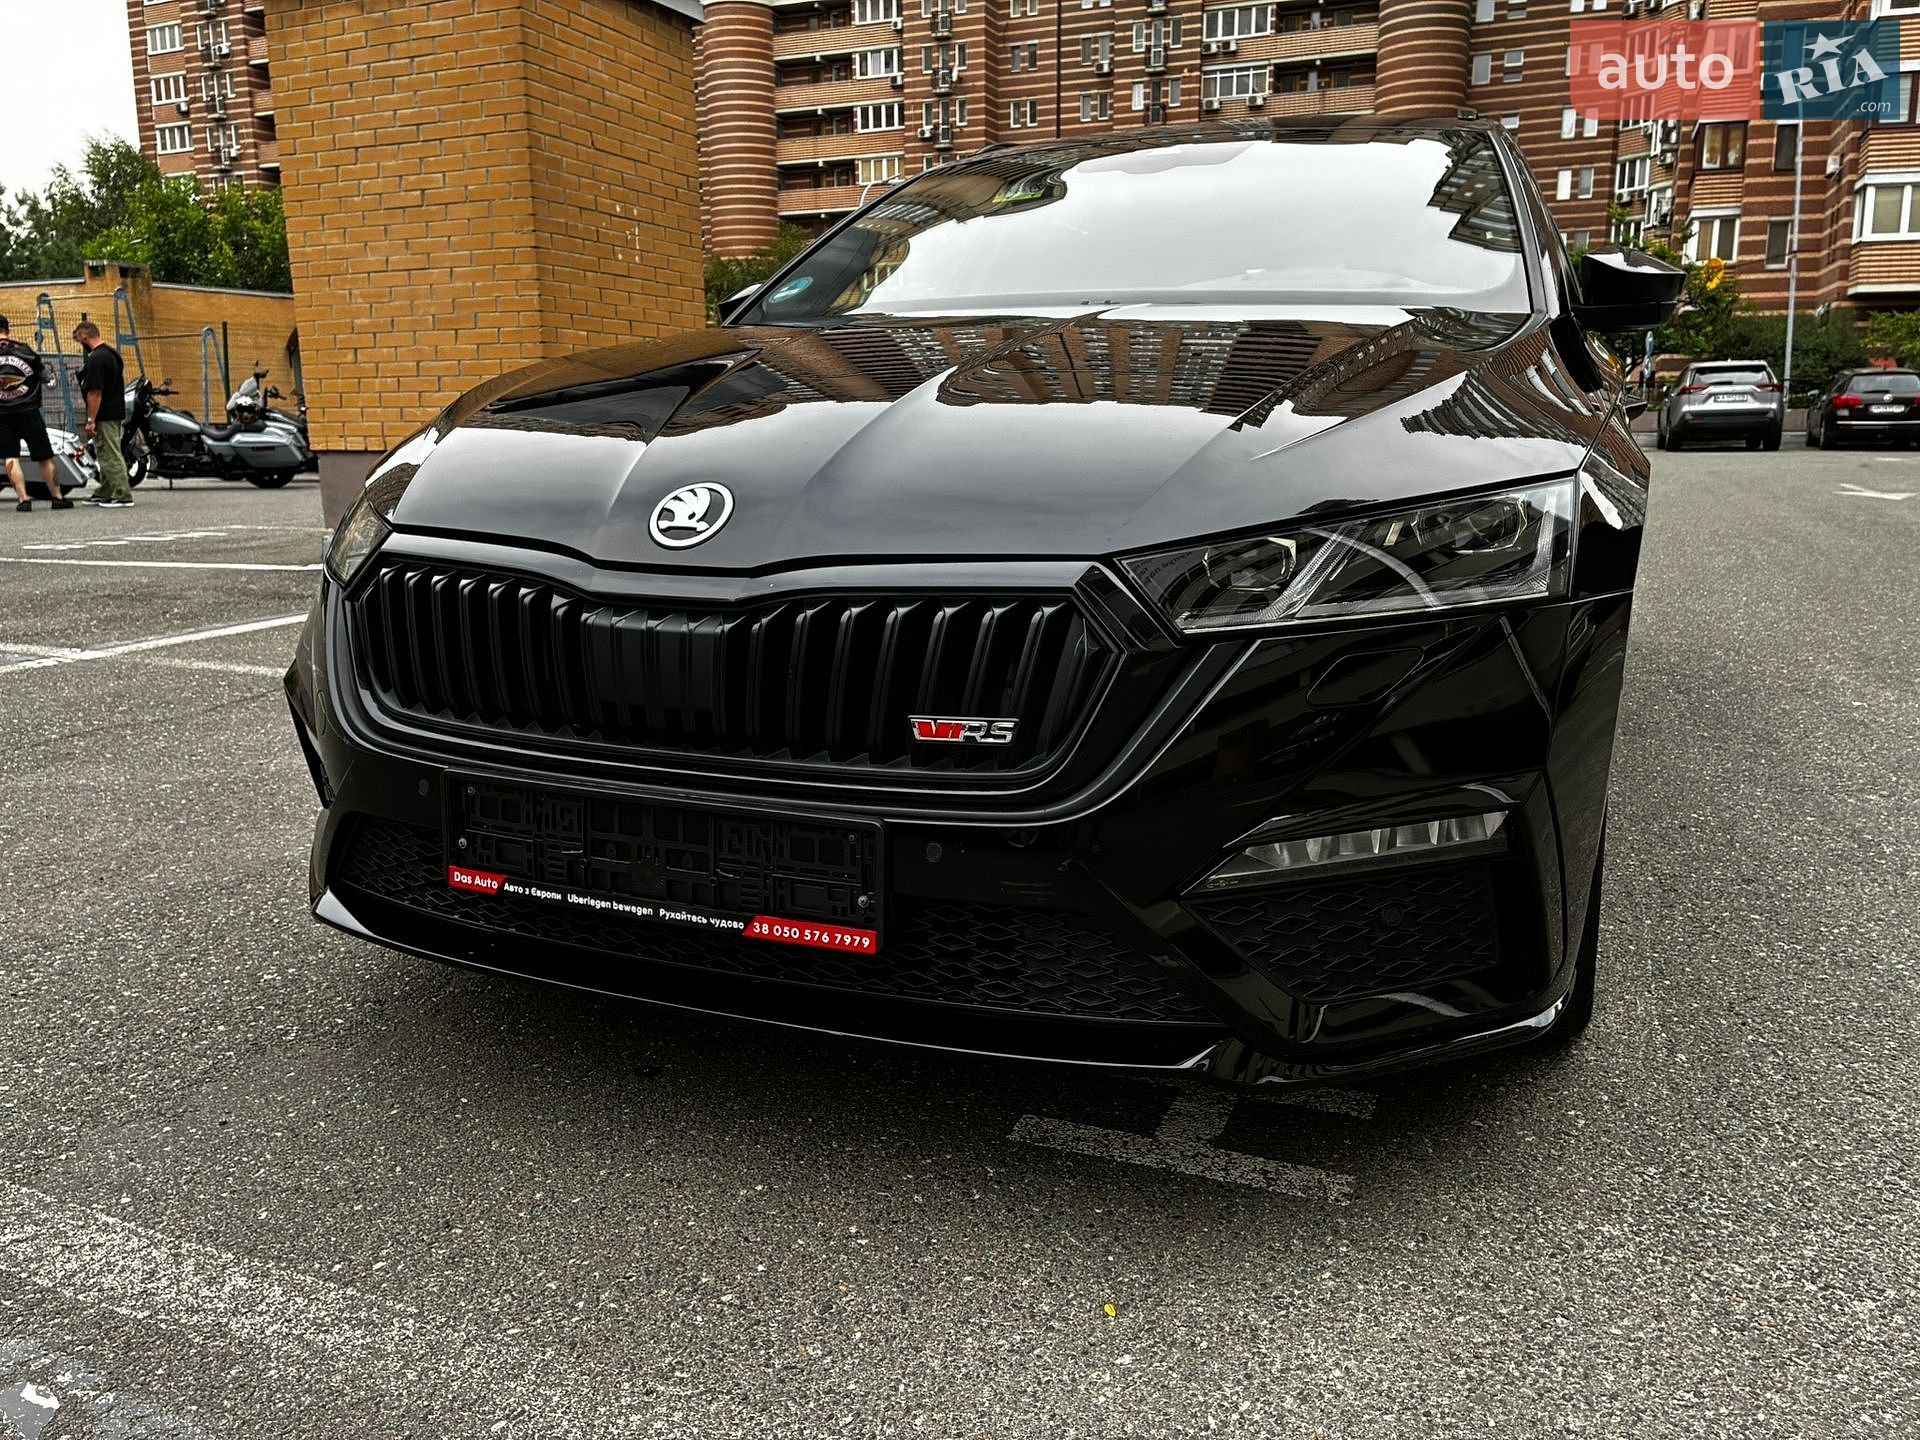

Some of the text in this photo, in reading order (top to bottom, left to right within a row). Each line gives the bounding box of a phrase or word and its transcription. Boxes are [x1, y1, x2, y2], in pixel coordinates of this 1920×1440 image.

[454, 871, 499, 889] Das Auto
[503, 882, 524, 893] Авто
[531, 887, 562, 901] Європи
[613, 901, 654, 916] bewegen
[659, 908, 745, 930] Рухайтесь чудово
[753, 922, 870, 949] 38 050 576 7979
